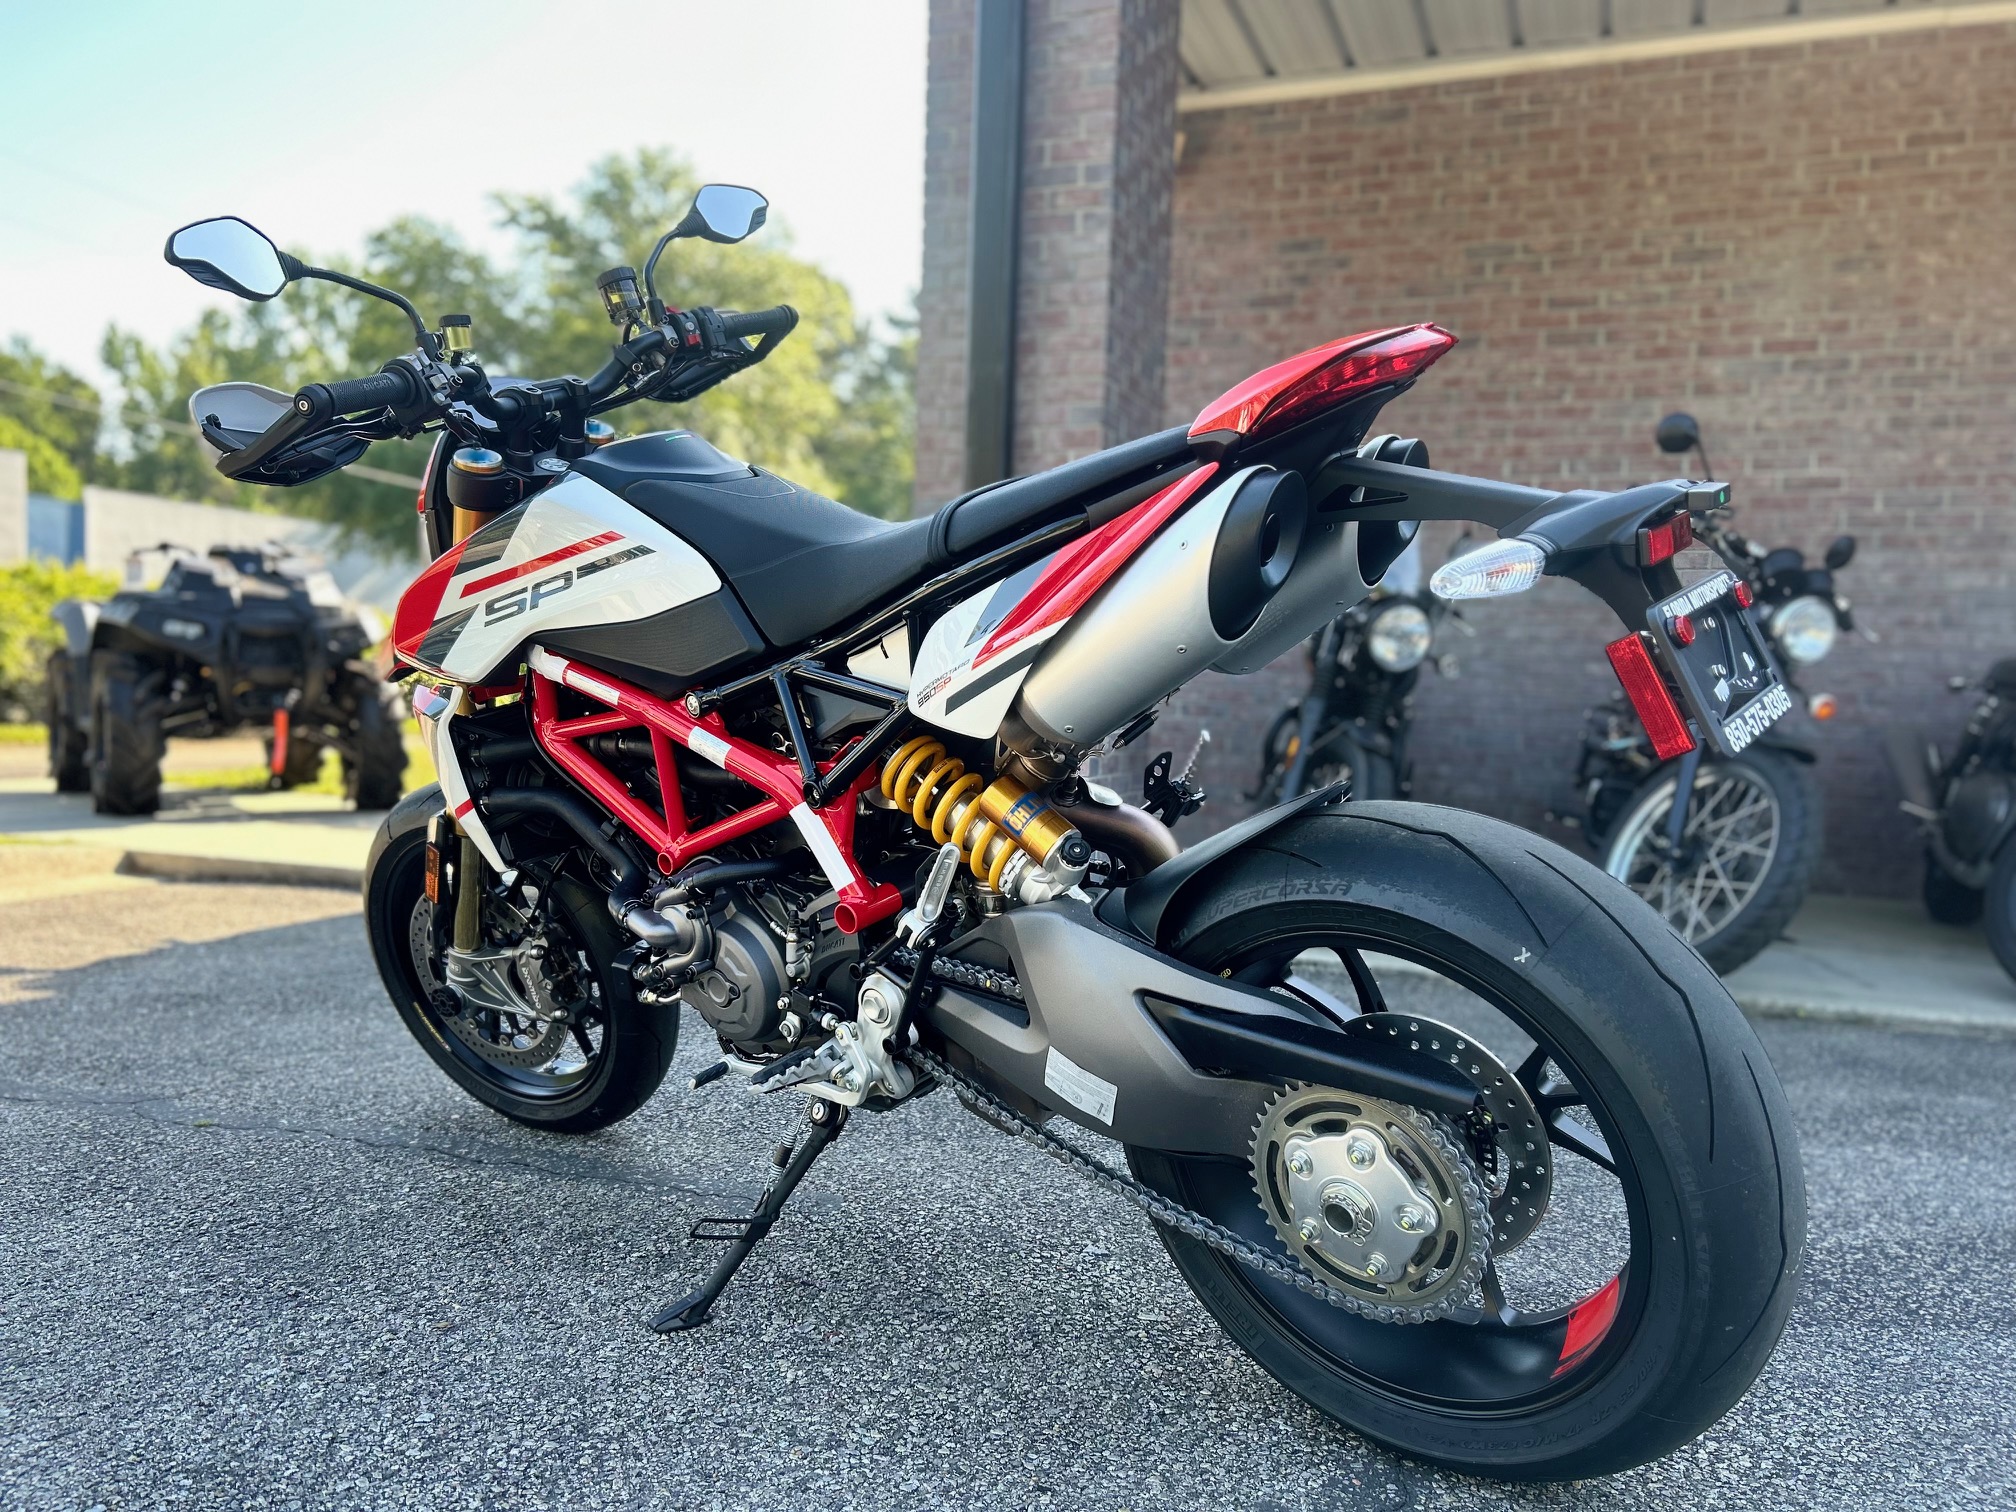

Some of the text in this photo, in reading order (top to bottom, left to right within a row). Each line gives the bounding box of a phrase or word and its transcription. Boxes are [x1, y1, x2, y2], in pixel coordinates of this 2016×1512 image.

[484, 570, 574, 628] SP
[1724, 684, 1792, 753] 850-575-0305
[521, 967, 542, 1009] brembo
